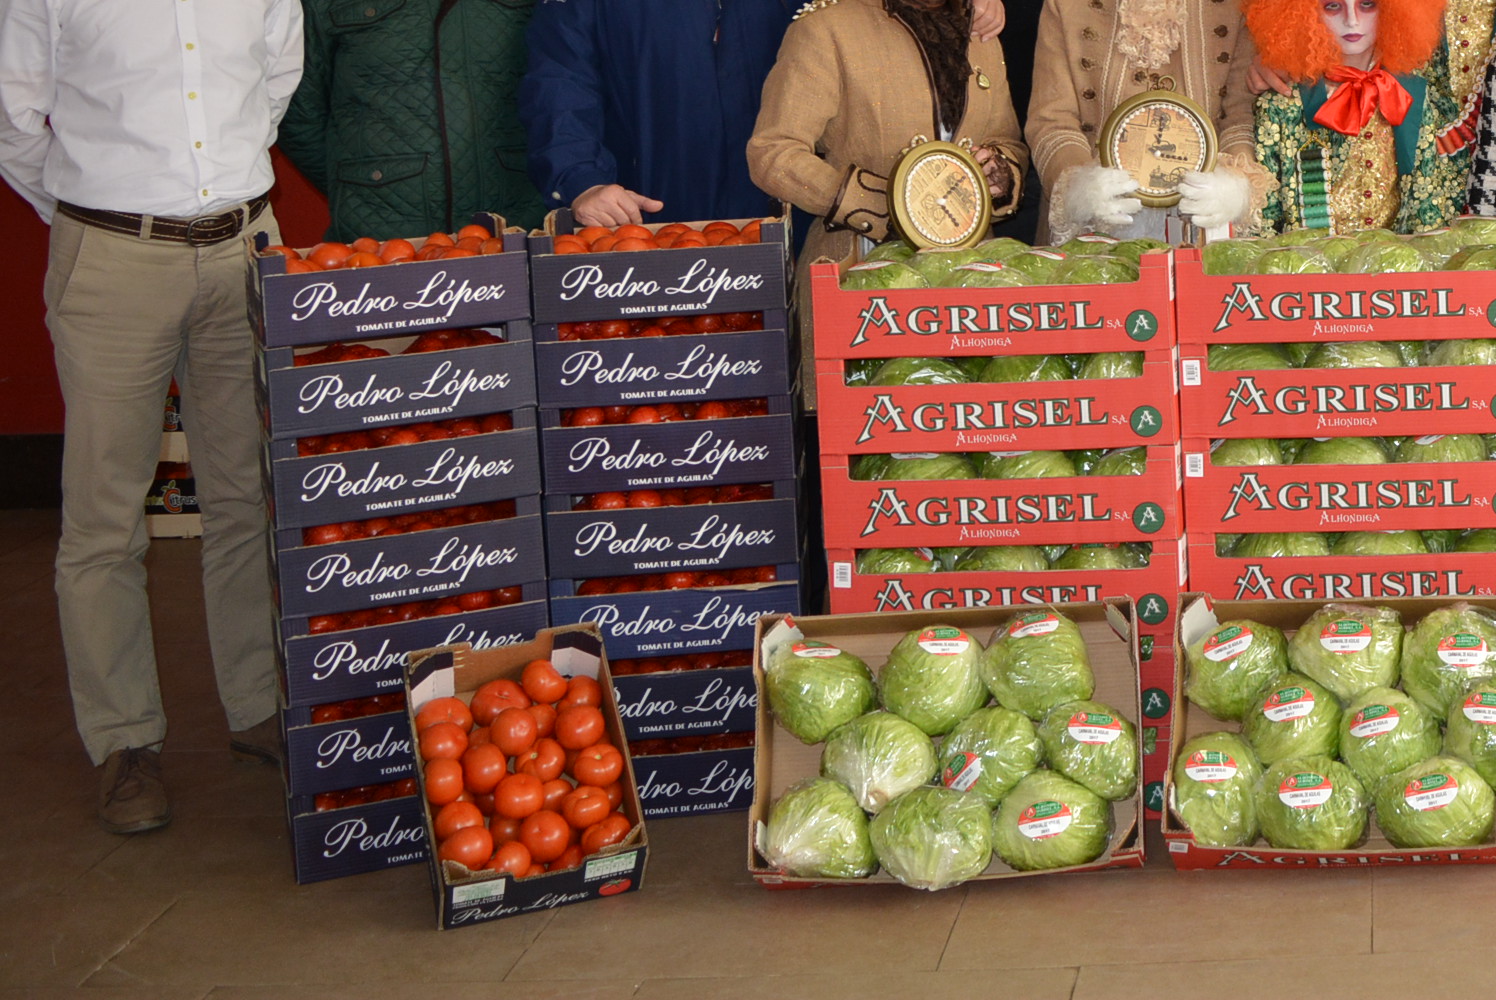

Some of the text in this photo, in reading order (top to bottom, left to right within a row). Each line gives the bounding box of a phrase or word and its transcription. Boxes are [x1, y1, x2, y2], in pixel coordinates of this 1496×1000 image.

[291, 270, 505, 321] Pedro López
[560, 258, 764, 304] Pedro López
[356, 316, 448, 333] TOMATE DE AGUILAS
[620, 302, 707, 315] TOMATE DE AGUILAS
[849, 296, 1104, 348] AGRISEL
[1213, 281, 1466, 333] AGRISEL
[950, 334, 1012, 350] ALHONDIGA
[1312, 320, 1374, 336] ALHONDIGA
[560, 344, 763, 389] Pedro López
[298, 360, 510, 414] Pedro López
[1218, 376, 1470, 427] AGRISEL
[362, 406, 454, 424] TOMATE DE AGUILAS
[855, 393, 1109, 445] AGRISEL
[1316, 414, 1378, 429] ALHONDIGA
[568, 430, 770, 475] Pedro López
[956, 431, 1017, 446] ALHONDIGA
[301, 447, 514, 502] Pedro López
[628, 473, 713, 486] TOMATE DE AGUILAS
[860, 487, 1112, 538] AGRISEL
[1221, 472, 1472, 523] AGRISEL
[959, 525, 1021, 541] ALHONDIGA
[1319, 510, 1381, 526] ALHONDIGA
[574, 514, 776, 559] Pedro López
[306, 536, 518, 593] Pedro López
[634, 557, 719, 570] TOMATE DE AGUILAS
[370, 582, 461, 601] TOMATE DE AGUILAS
[1235, 564, 1476, 600] AGRISEL
[578, 603, 676, 637] Pedro
[637, 638, 722, 652] TOMATE DE AGUILAS
[614, 677, 760, 721] edro Lópe
[638, 719, 724, 733] TOMATE DE AGUILAS
[317, 726, 412, 769] Pedr
[380, 764, 413, 776] TOMAT
[643, 802, 729, 816] TOMATE DE AGUILAS
[324, 815, 425, 858] Pedro
[451, 904, 520, 925] Pedro
[523, 891, 592, 910] López
